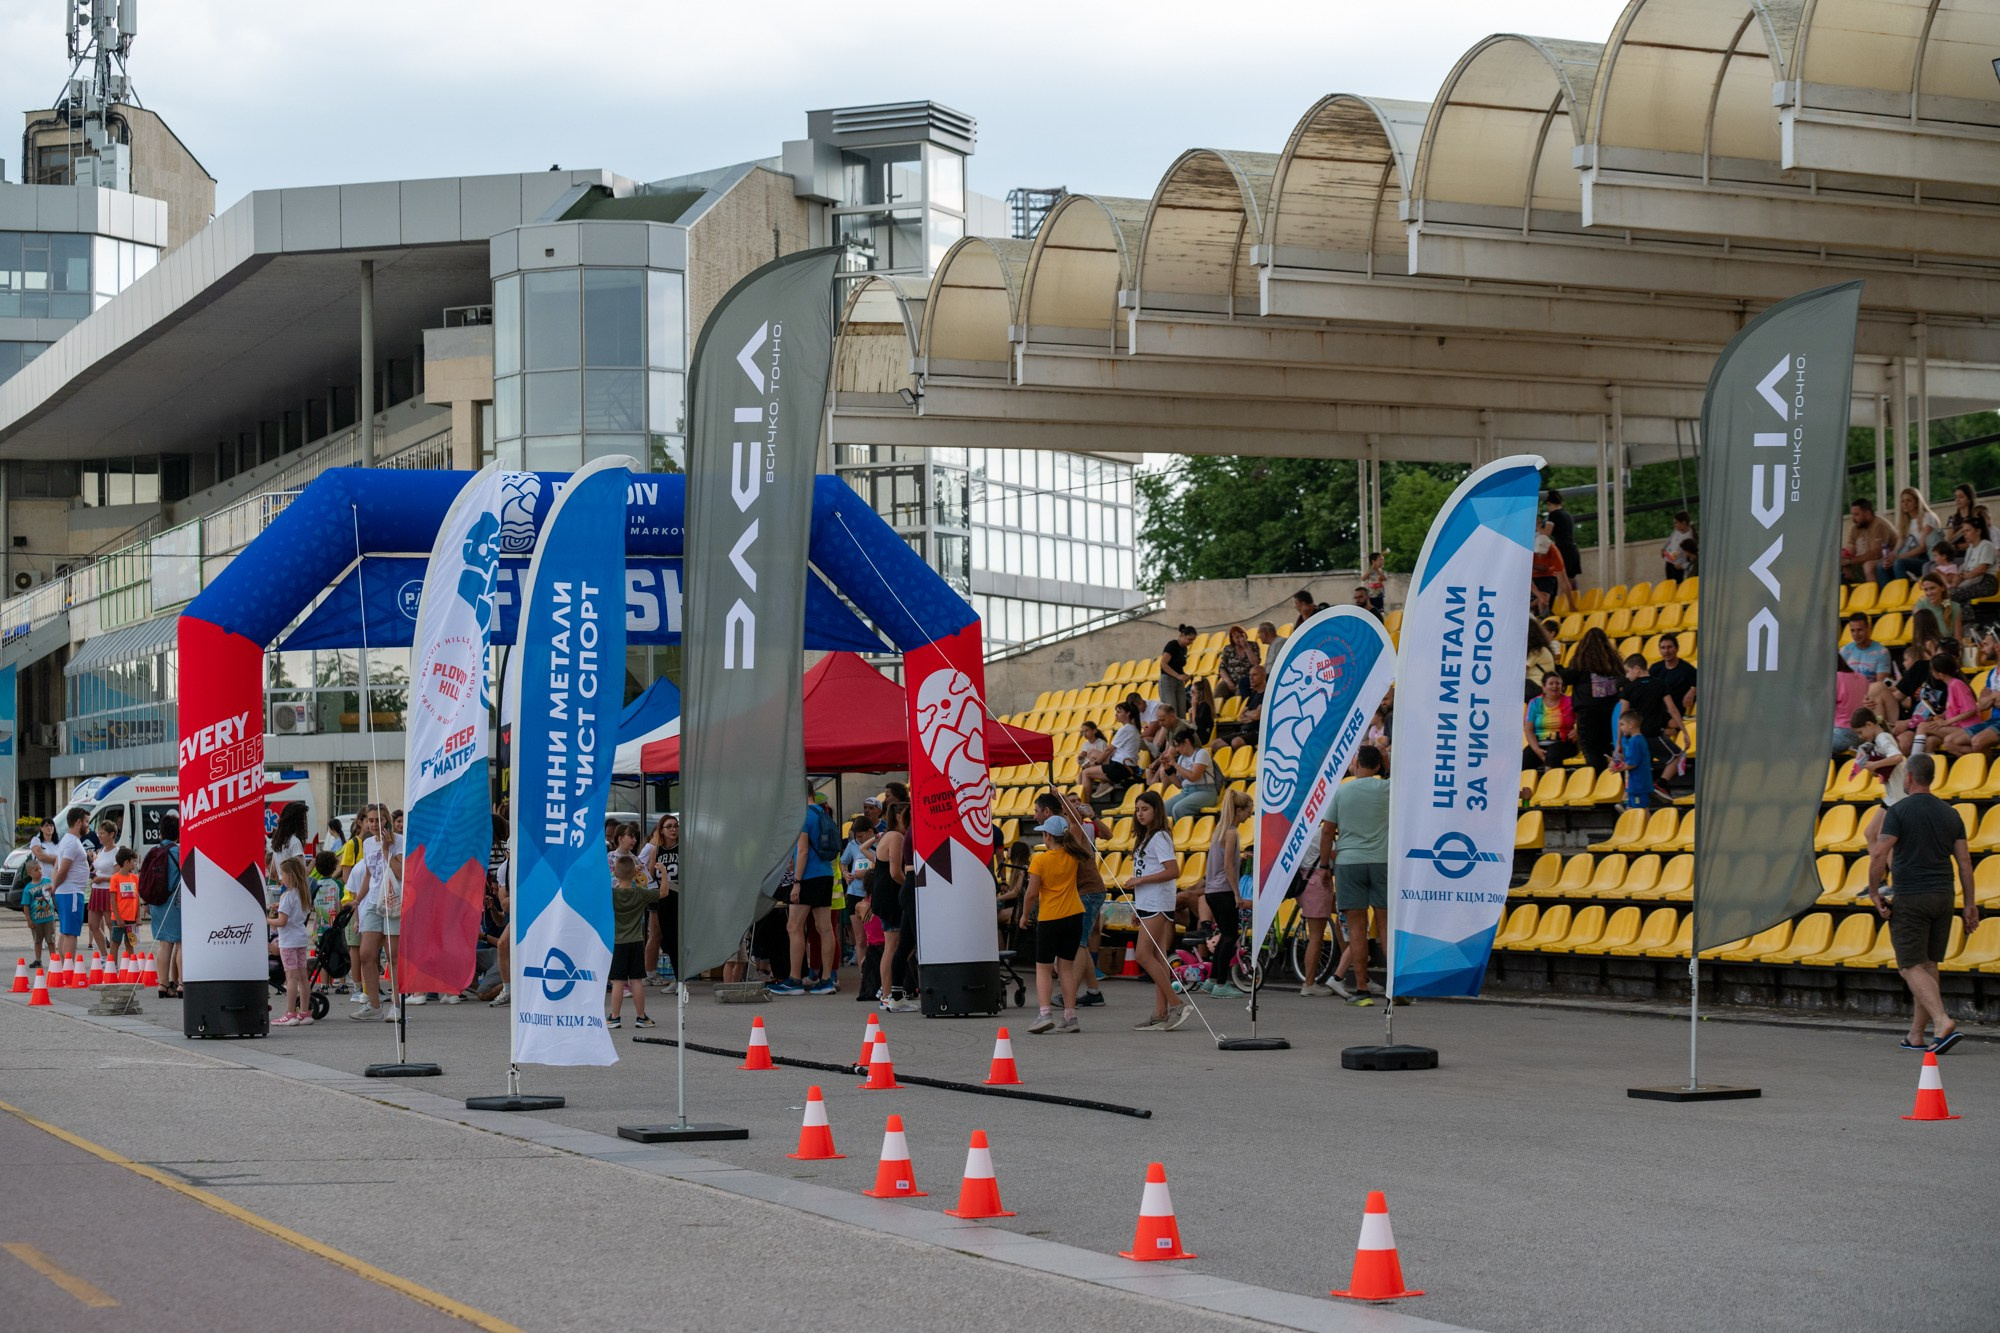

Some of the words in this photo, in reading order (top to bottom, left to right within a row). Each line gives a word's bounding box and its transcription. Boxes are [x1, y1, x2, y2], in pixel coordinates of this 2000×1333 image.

[770, 320, 783, 394] ТОЧНО.
[1794, 353, 1806, 420] ТОЧНО.
[766, 398, 779, 483] ВСИЧКО.
[1791, 424, 1803, 502] ВСИЧКО.
[631, 515, 645, 524] IN
[724, 320, 769, 669] DACIA
[1746, 353, 1791, 672] DACIA
[549, 581, 572, 721] МЕТАЛИ
[578, 581, 600, 699] СПОРТ
[1316, 654, 1346, 671] PLOVDIV
[1439, 586, 1467, 704] МЕТАЛИ
[1472, 585, 1497, 685] СПОРТ
[1322, 667, 1343, 680] HILLS
[180, 710, 249, 770] EVERY
[445, 724, 475, 754] STEP
[575, 708, 596, 796] ЧИСТ
[1433, 713, 1458, 808] ЦЕННИ
[1468, 693, 1490, 768] ЧИСТ
[545, 731, 568, 845] ЦЕННИ
[922, 789, 956, 806] PLOVDIV
[929, 801, 953, 815] HILLS
[1280, 817, 1309, 874] EVERY
[1304, 777, 1327, 824] STEP
[1323, 707, 1365, 785] MATTERS
[1466, 776, 1488, 811] ЗА
[569, 806, 589, 849] ЗА
[1401, 889, 1454, 902] ХОЛДИНГ
[1456, 891, 1485, 904] КЦМ
[556, 1015, 585, 1028] КЦМ
